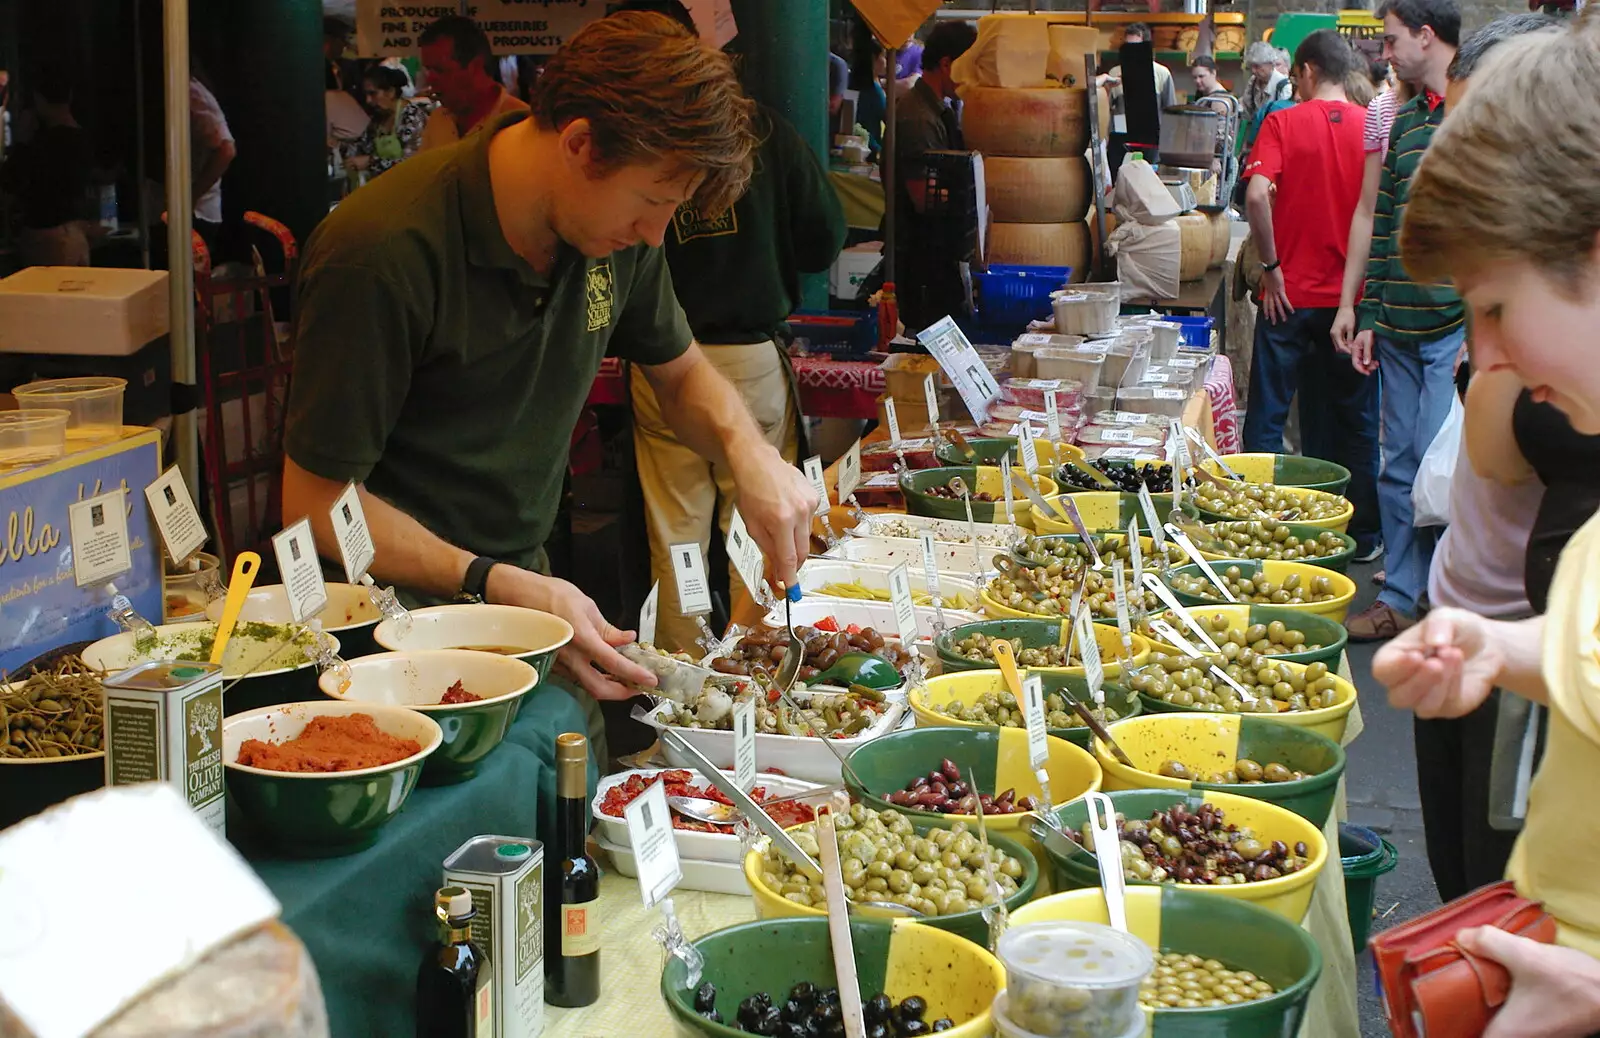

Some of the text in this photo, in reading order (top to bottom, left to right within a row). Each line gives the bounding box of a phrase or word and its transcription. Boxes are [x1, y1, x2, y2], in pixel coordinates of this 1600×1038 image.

[380, 7, 456, 18] PRODUCERS
[381, 22, 408, 33] FINE
[476, 21, 548, 32] LUEBERRIES
[383, 37, 412, 48] AND
[493, 36, 562, 47] PRODUCTS
[189, 749, 220, 774] THE FRESH
[189, 762, 221, 792] OLIVE
[190, 779, 220, 806] COMPANY
[520, 930, 541, 962] OLIVE
